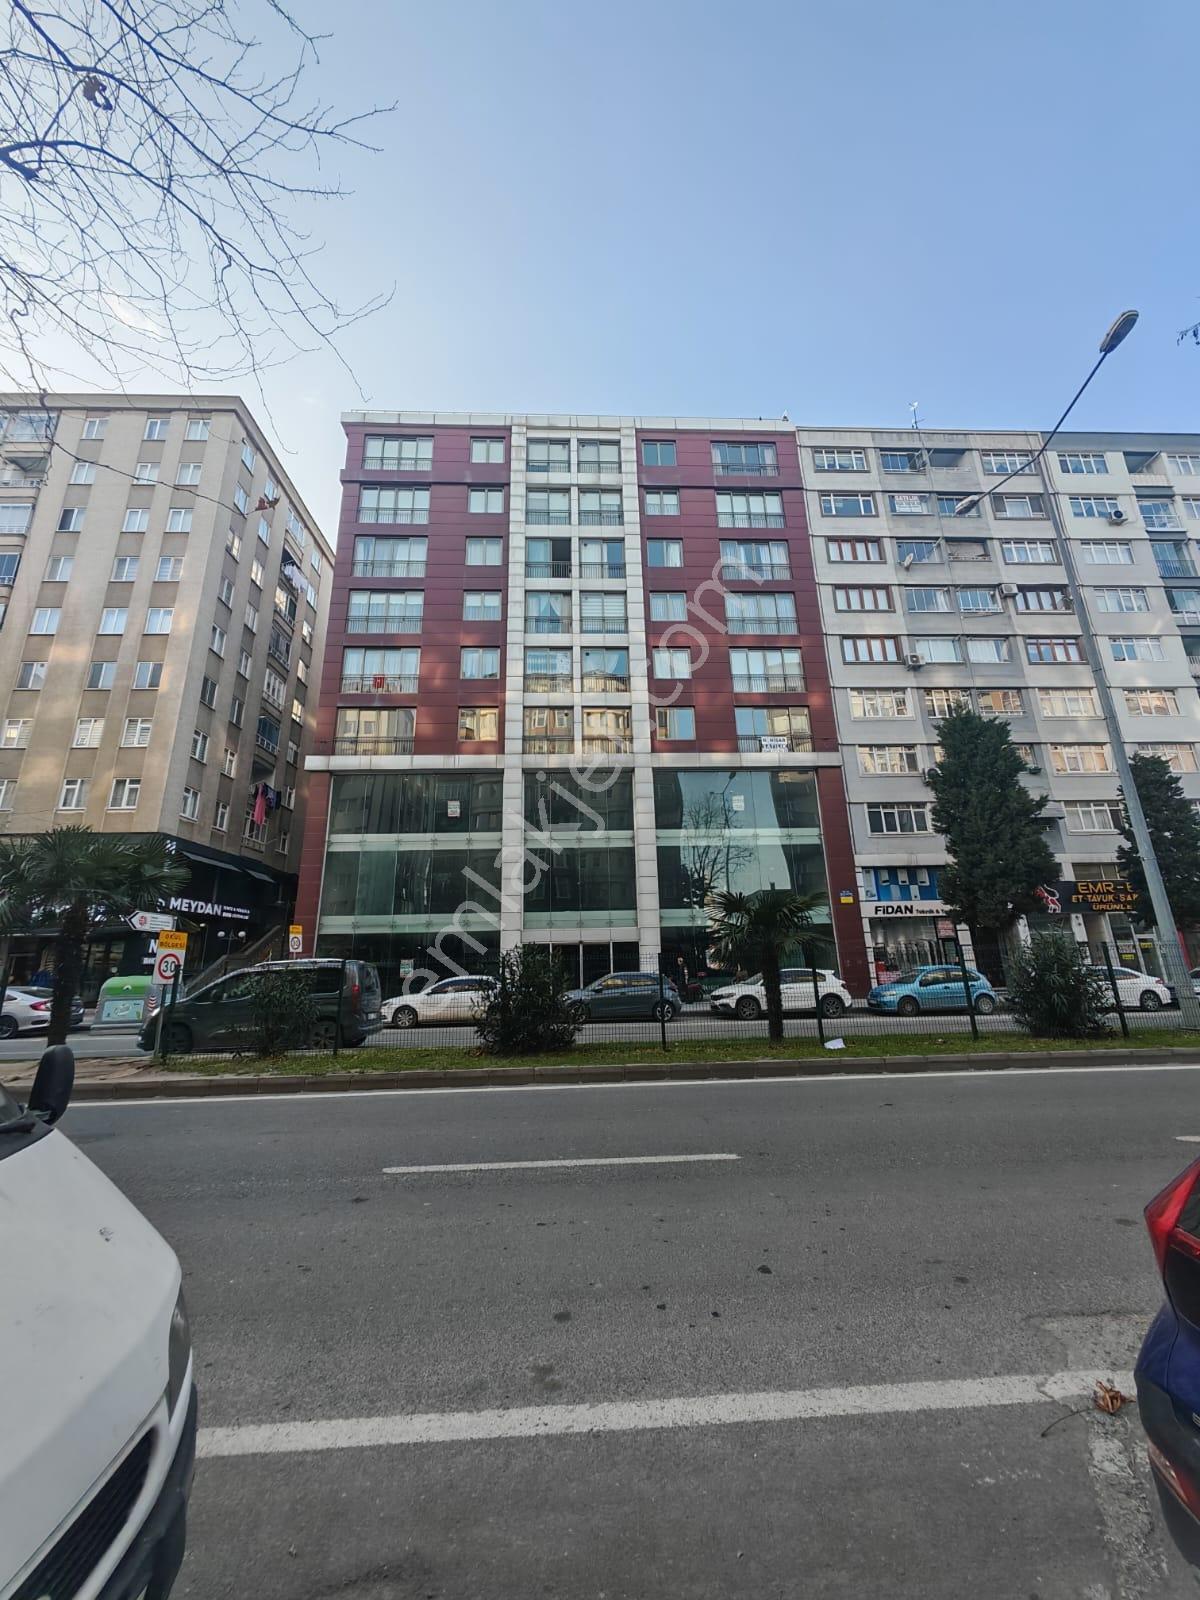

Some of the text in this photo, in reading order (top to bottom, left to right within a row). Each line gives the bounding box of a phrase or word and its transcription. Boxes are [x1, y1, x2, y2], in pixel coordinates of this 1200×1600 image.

[169, 897, 222, 916] MEYDAN
[1093, 902, 1133, 910] ÜRÜNLE
[162, 960, 177, 973] 30
